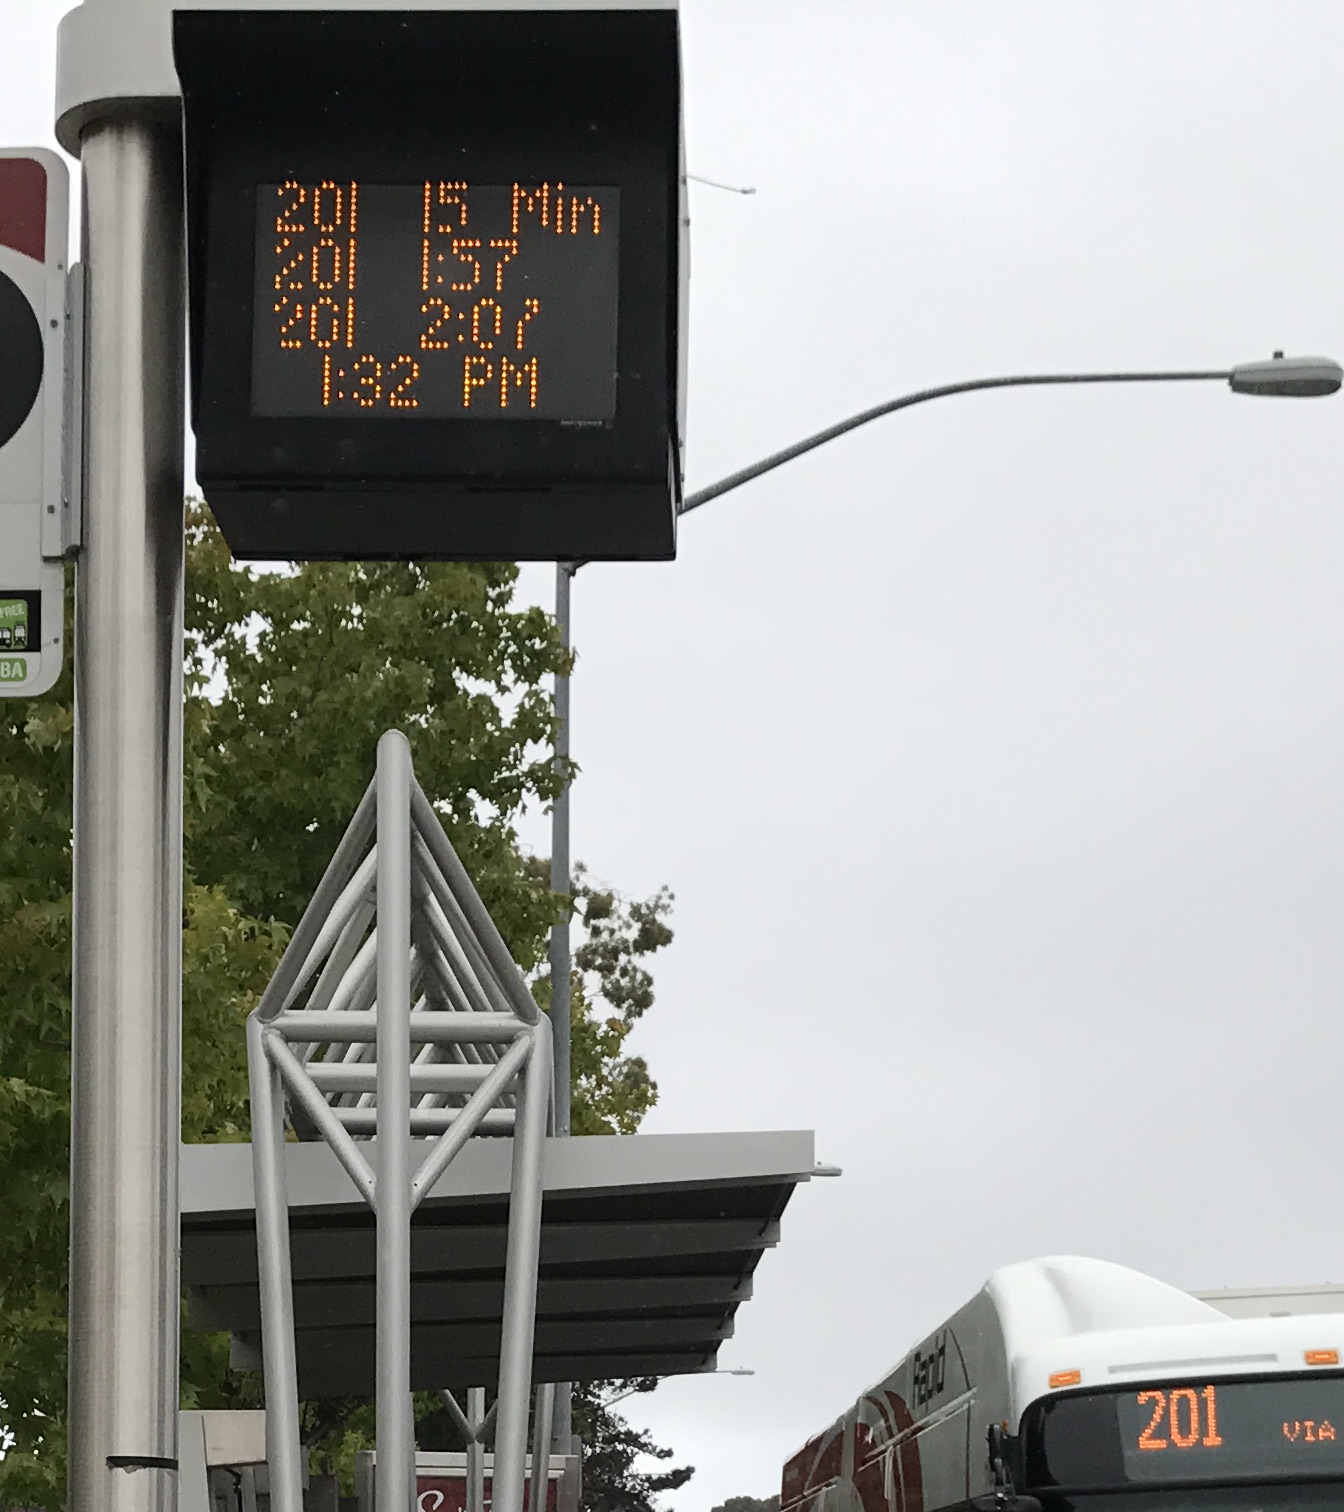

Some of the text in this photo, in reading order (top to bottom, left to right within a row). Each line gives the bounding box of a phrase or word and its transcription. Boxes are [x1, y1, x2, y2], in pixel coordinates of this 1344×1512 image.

[275, 180, 601, 234] 201 15 Min
[272, 236, 520, 291] 201 1:57
[271, 294, 540, 350] 201 2:07
[321, 353, 538, 407] 1:32 PM
[1137, 1384, 1224, 1450] 201
[1282, 1420, 1337, 1443] VIA
